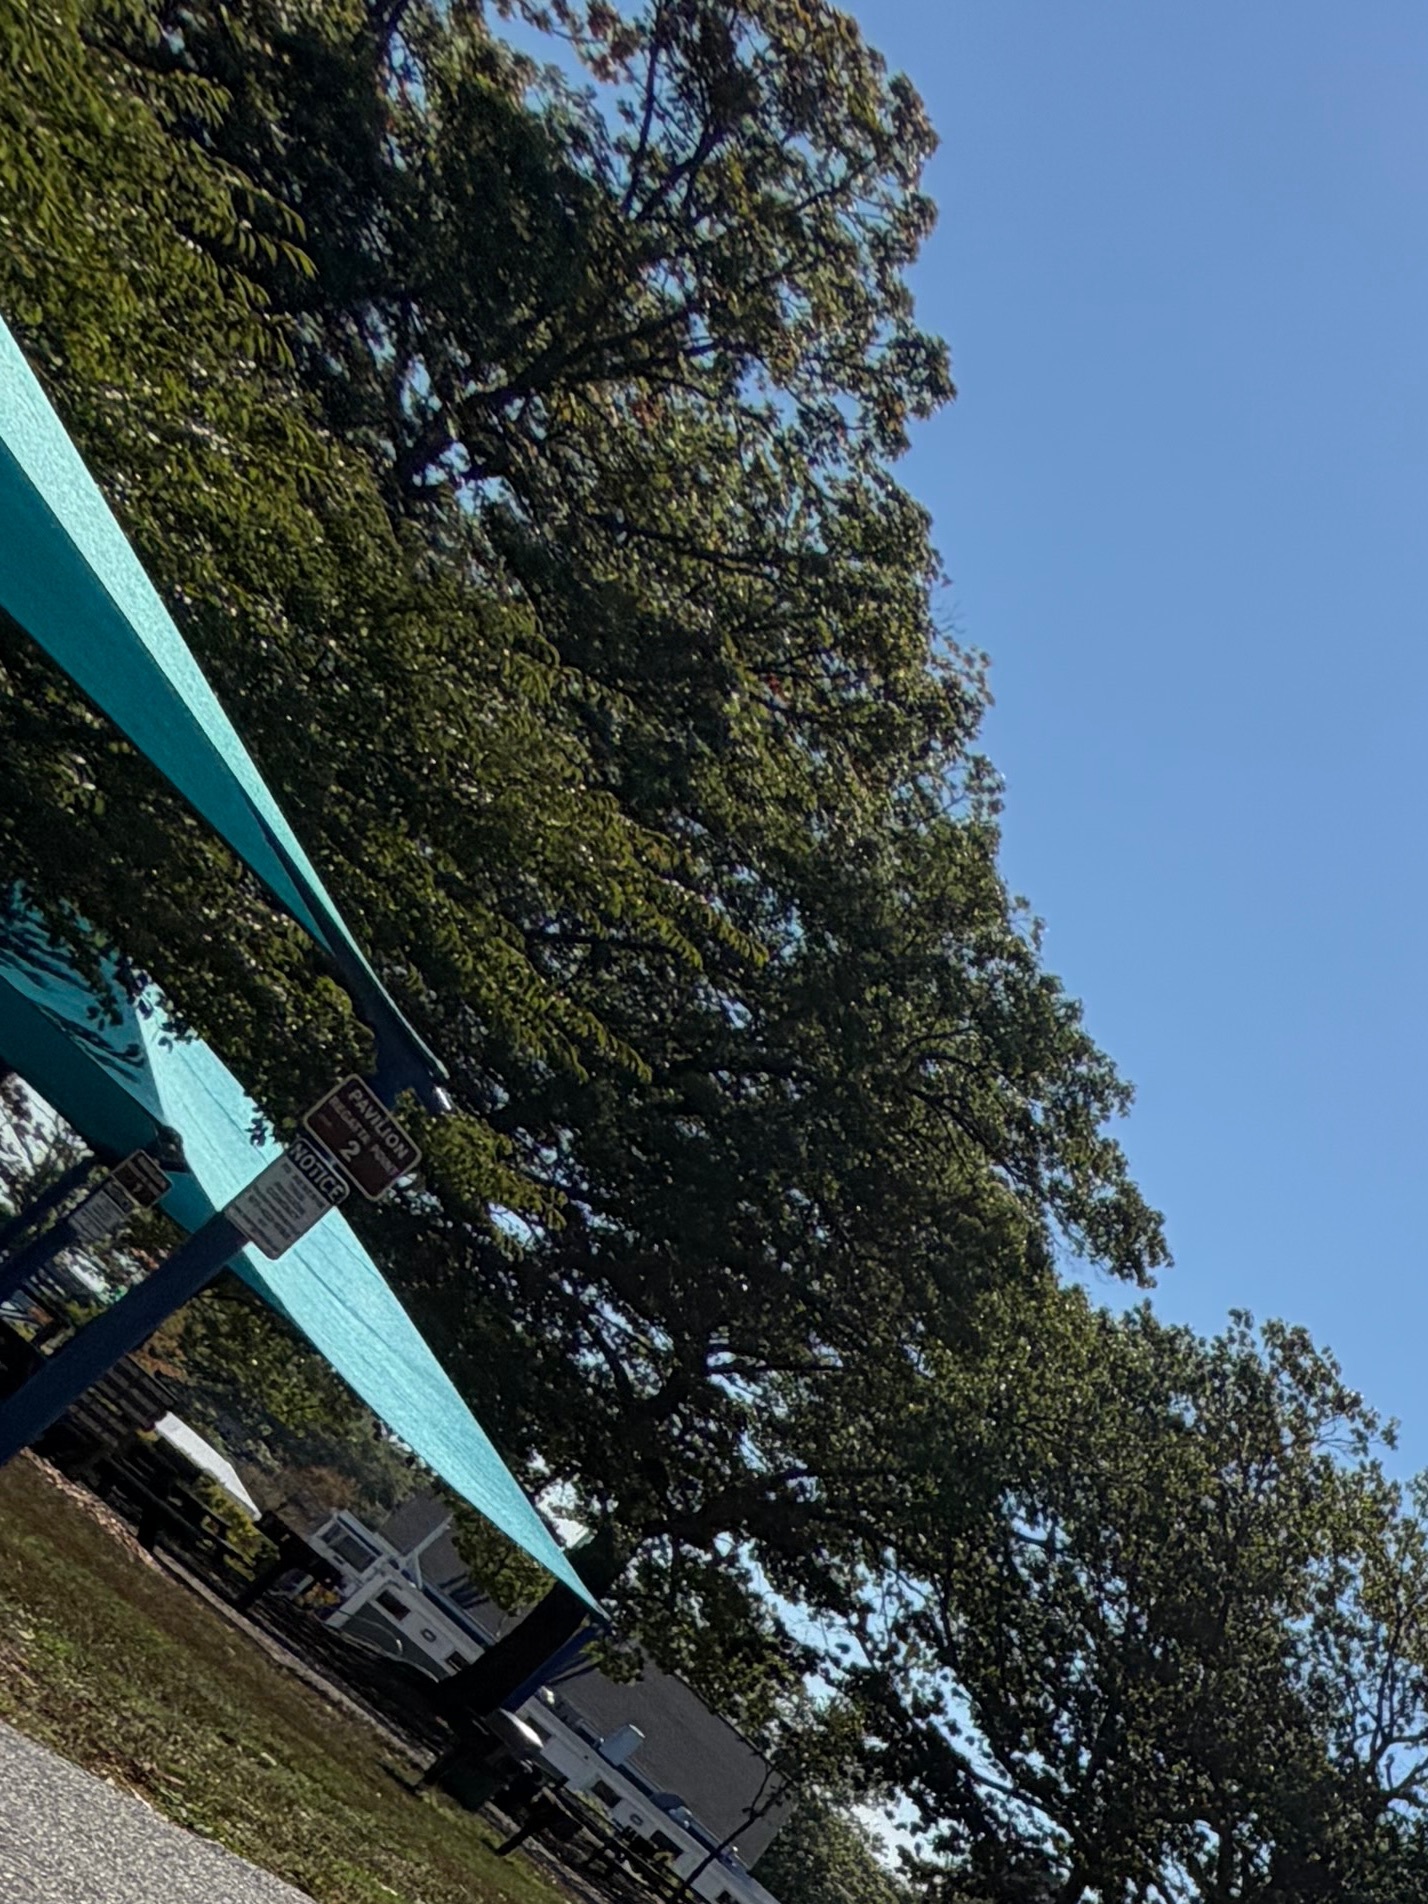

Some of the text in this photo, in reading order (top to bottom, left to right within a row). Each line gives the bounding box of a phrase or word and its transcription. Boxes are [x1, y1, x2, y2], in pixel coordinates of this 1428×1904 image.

[327, 1095, 401, 1179] REGATTA POINT
[337, 1137, 364, 1164] 2
[347, 1088, 411, 1161] PAVILION
[287, 1141, 346, 1203] NOTICE
